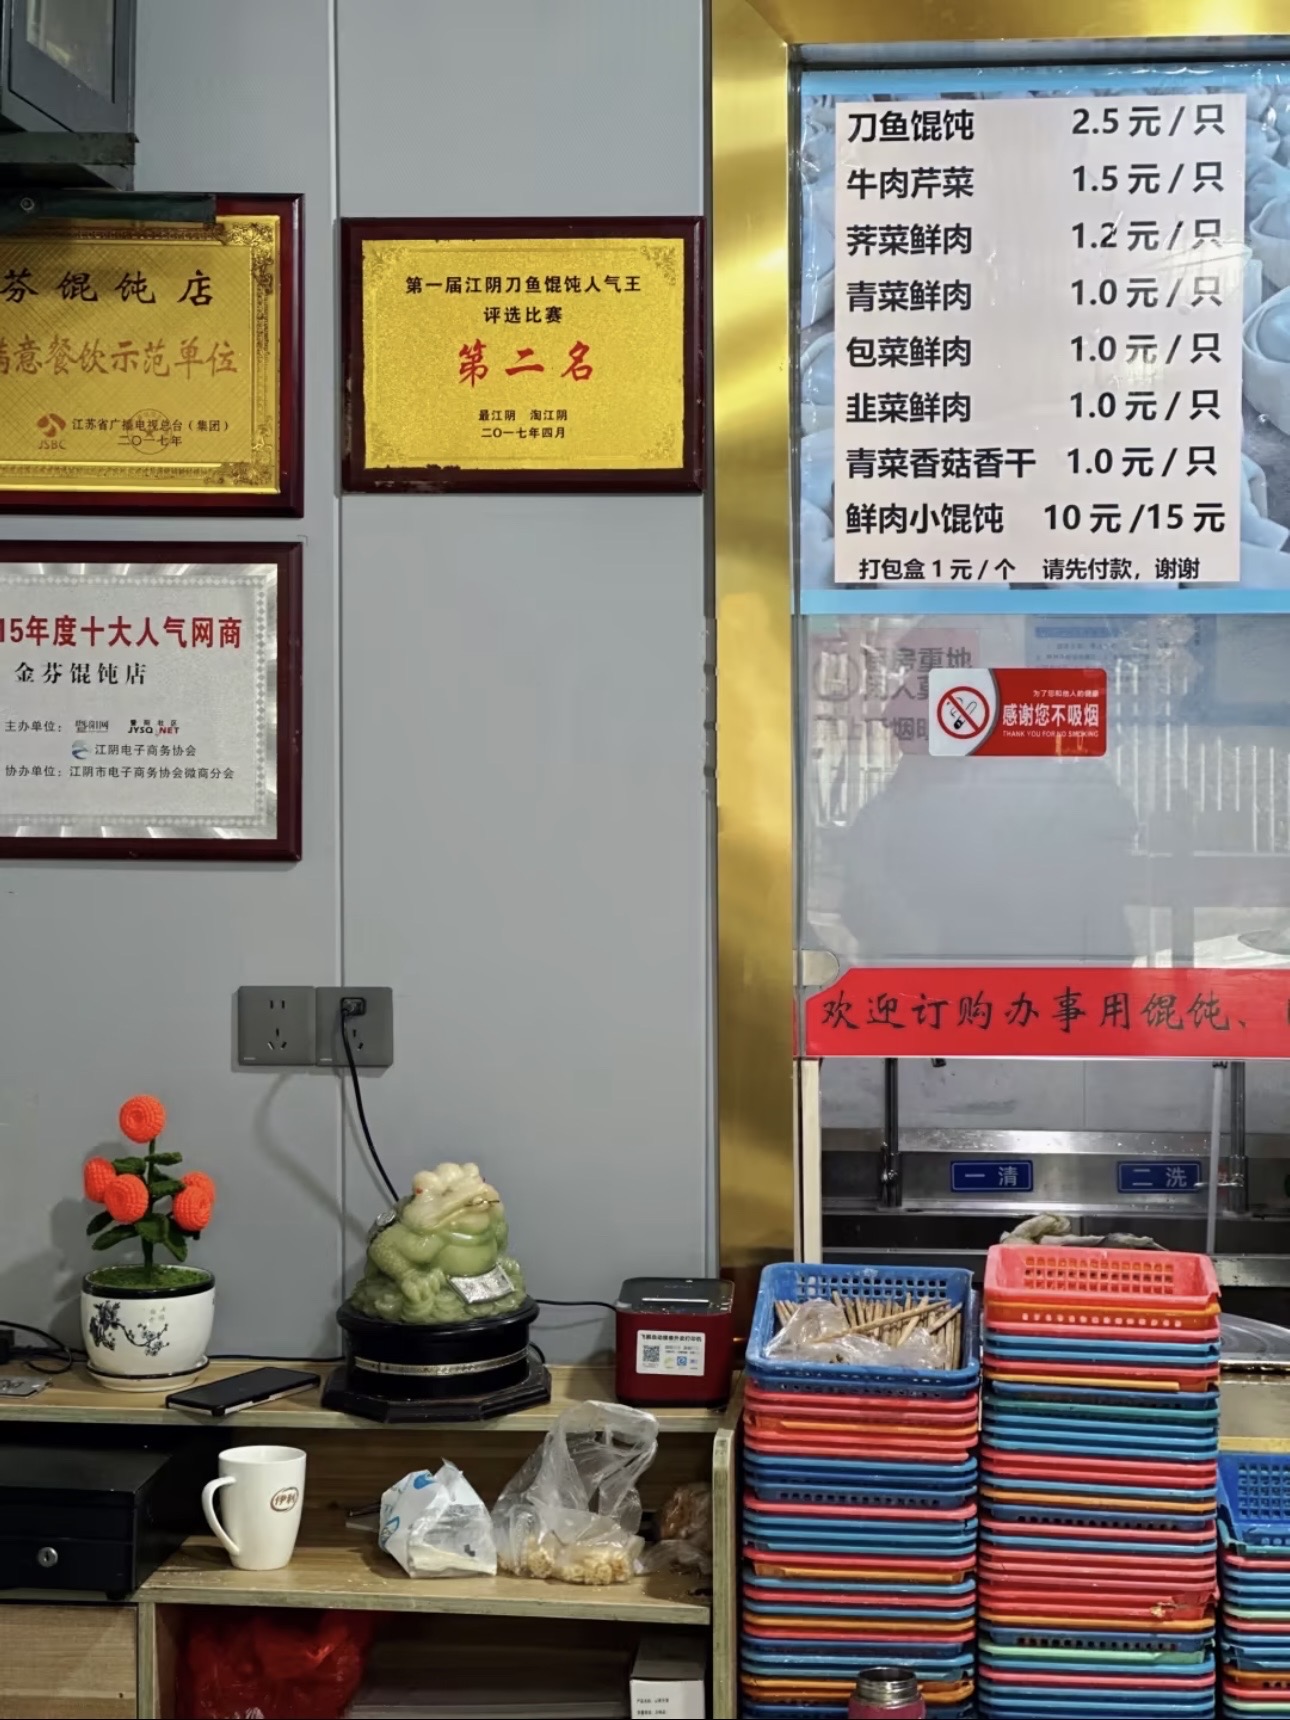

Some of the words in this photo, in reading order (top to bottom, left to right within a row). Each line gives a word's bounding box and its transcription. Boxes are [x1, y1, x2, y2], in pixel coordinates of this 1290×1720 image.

[847, 109, 974, 143] 刀鱼馄饨
[847, 167, 974, 199] 牛肉芹菜
[846, 223, 973, 256] 荠菜鲜肉
[405, 275, 641, 295] 第一届江阴刀鱼馄饨人气王
[846, 280, 972, 312] 青菜鲜肉
[483, 306, 563, 324] 评选比赛
[458, 338, 593, 388] 第二名
[846, 335, 972, 368] 包菜鲜肉
[478, 410, 516, 422] 最江阴
[530, 410, 567, 422] 淘江阴
[846, 392, 972, 424] 韭菜鲜肉
[38, 440, 66, 450] JSBC
[846, 447, 1036, 479] 青菜香菇香干
[846, 503, 1004, 535] 鲜肉小馄饨
[14, 662, 147, 685] 金芬馄饨店
[1002, 703, 1099, 728] 感谢您不吸烟
[1002, 730, 1024, 738] THANK
[1027, 730, 1041, 738] YOU
[1042, 730, 1055, 738] FOR
[1068, 730, 1099, 738] SMOKING
[95, 744, 197, 756] 江阴电子商务协会
[69, 766, 234, 779] 江阴市电子商务协会微商分会
[821, 985, 1290, 1035] 欢迎订购办事用馄饨、
[964, 1165, 1018, 1187] 一清
[1132, 1165, 1187, 1188] 二洗
